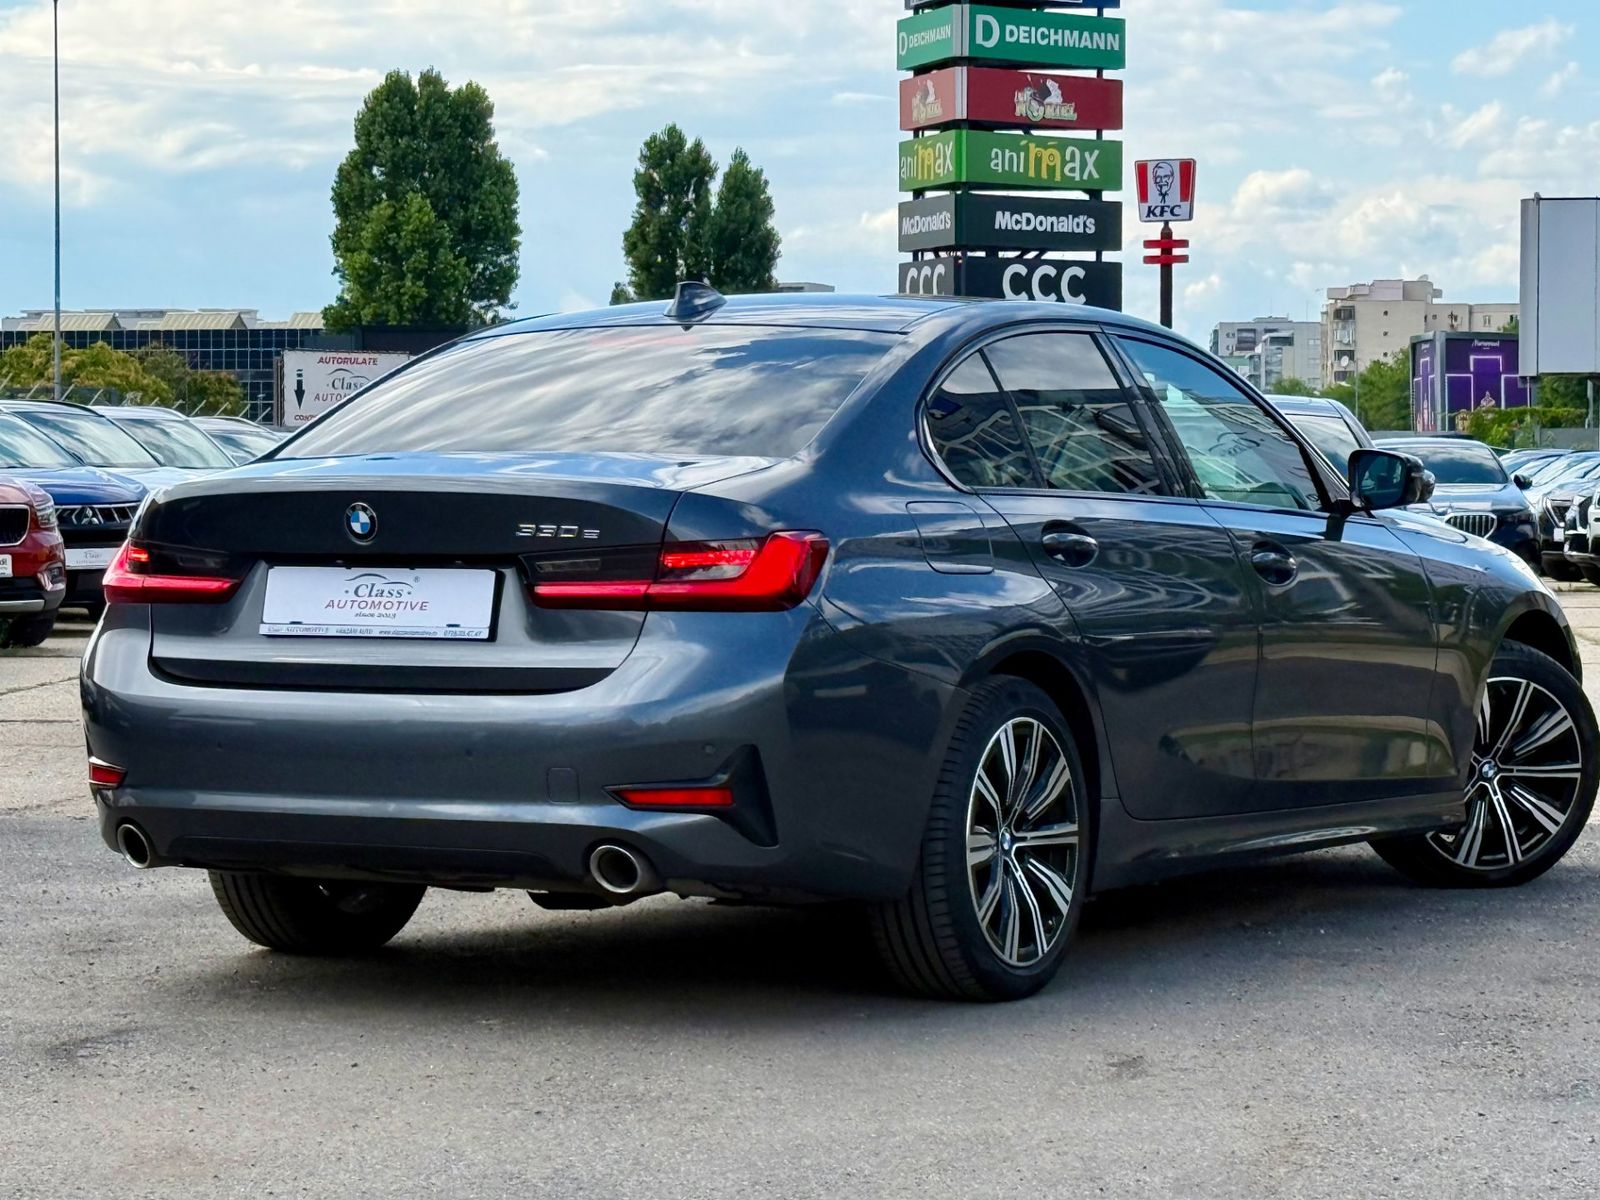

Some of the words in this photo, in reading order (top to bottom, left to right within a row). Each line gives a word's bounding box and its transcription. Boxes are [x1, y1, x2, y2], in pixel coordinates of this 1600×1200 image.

[909, 23, 952, 48] DEICHMANN
[975, 14, 1000, 48] D
[1005, 24, 1120, 51] DEICHMANN
[900, 140, 953, 181] animax
[990, 140, 1100, 182] animax
[902, 210, 952, 236] McDonald's
[994, 211, 1096, 234] McDonald's
[1145, 204, 1182, 218] KFC
[1002, 263, 1087, 305] CCC
[317, 356, 378, 366] AUTORULATE
[354, 583, 404, 598] Class
[324, 599, 429, 611] AUTOMOTIVE
